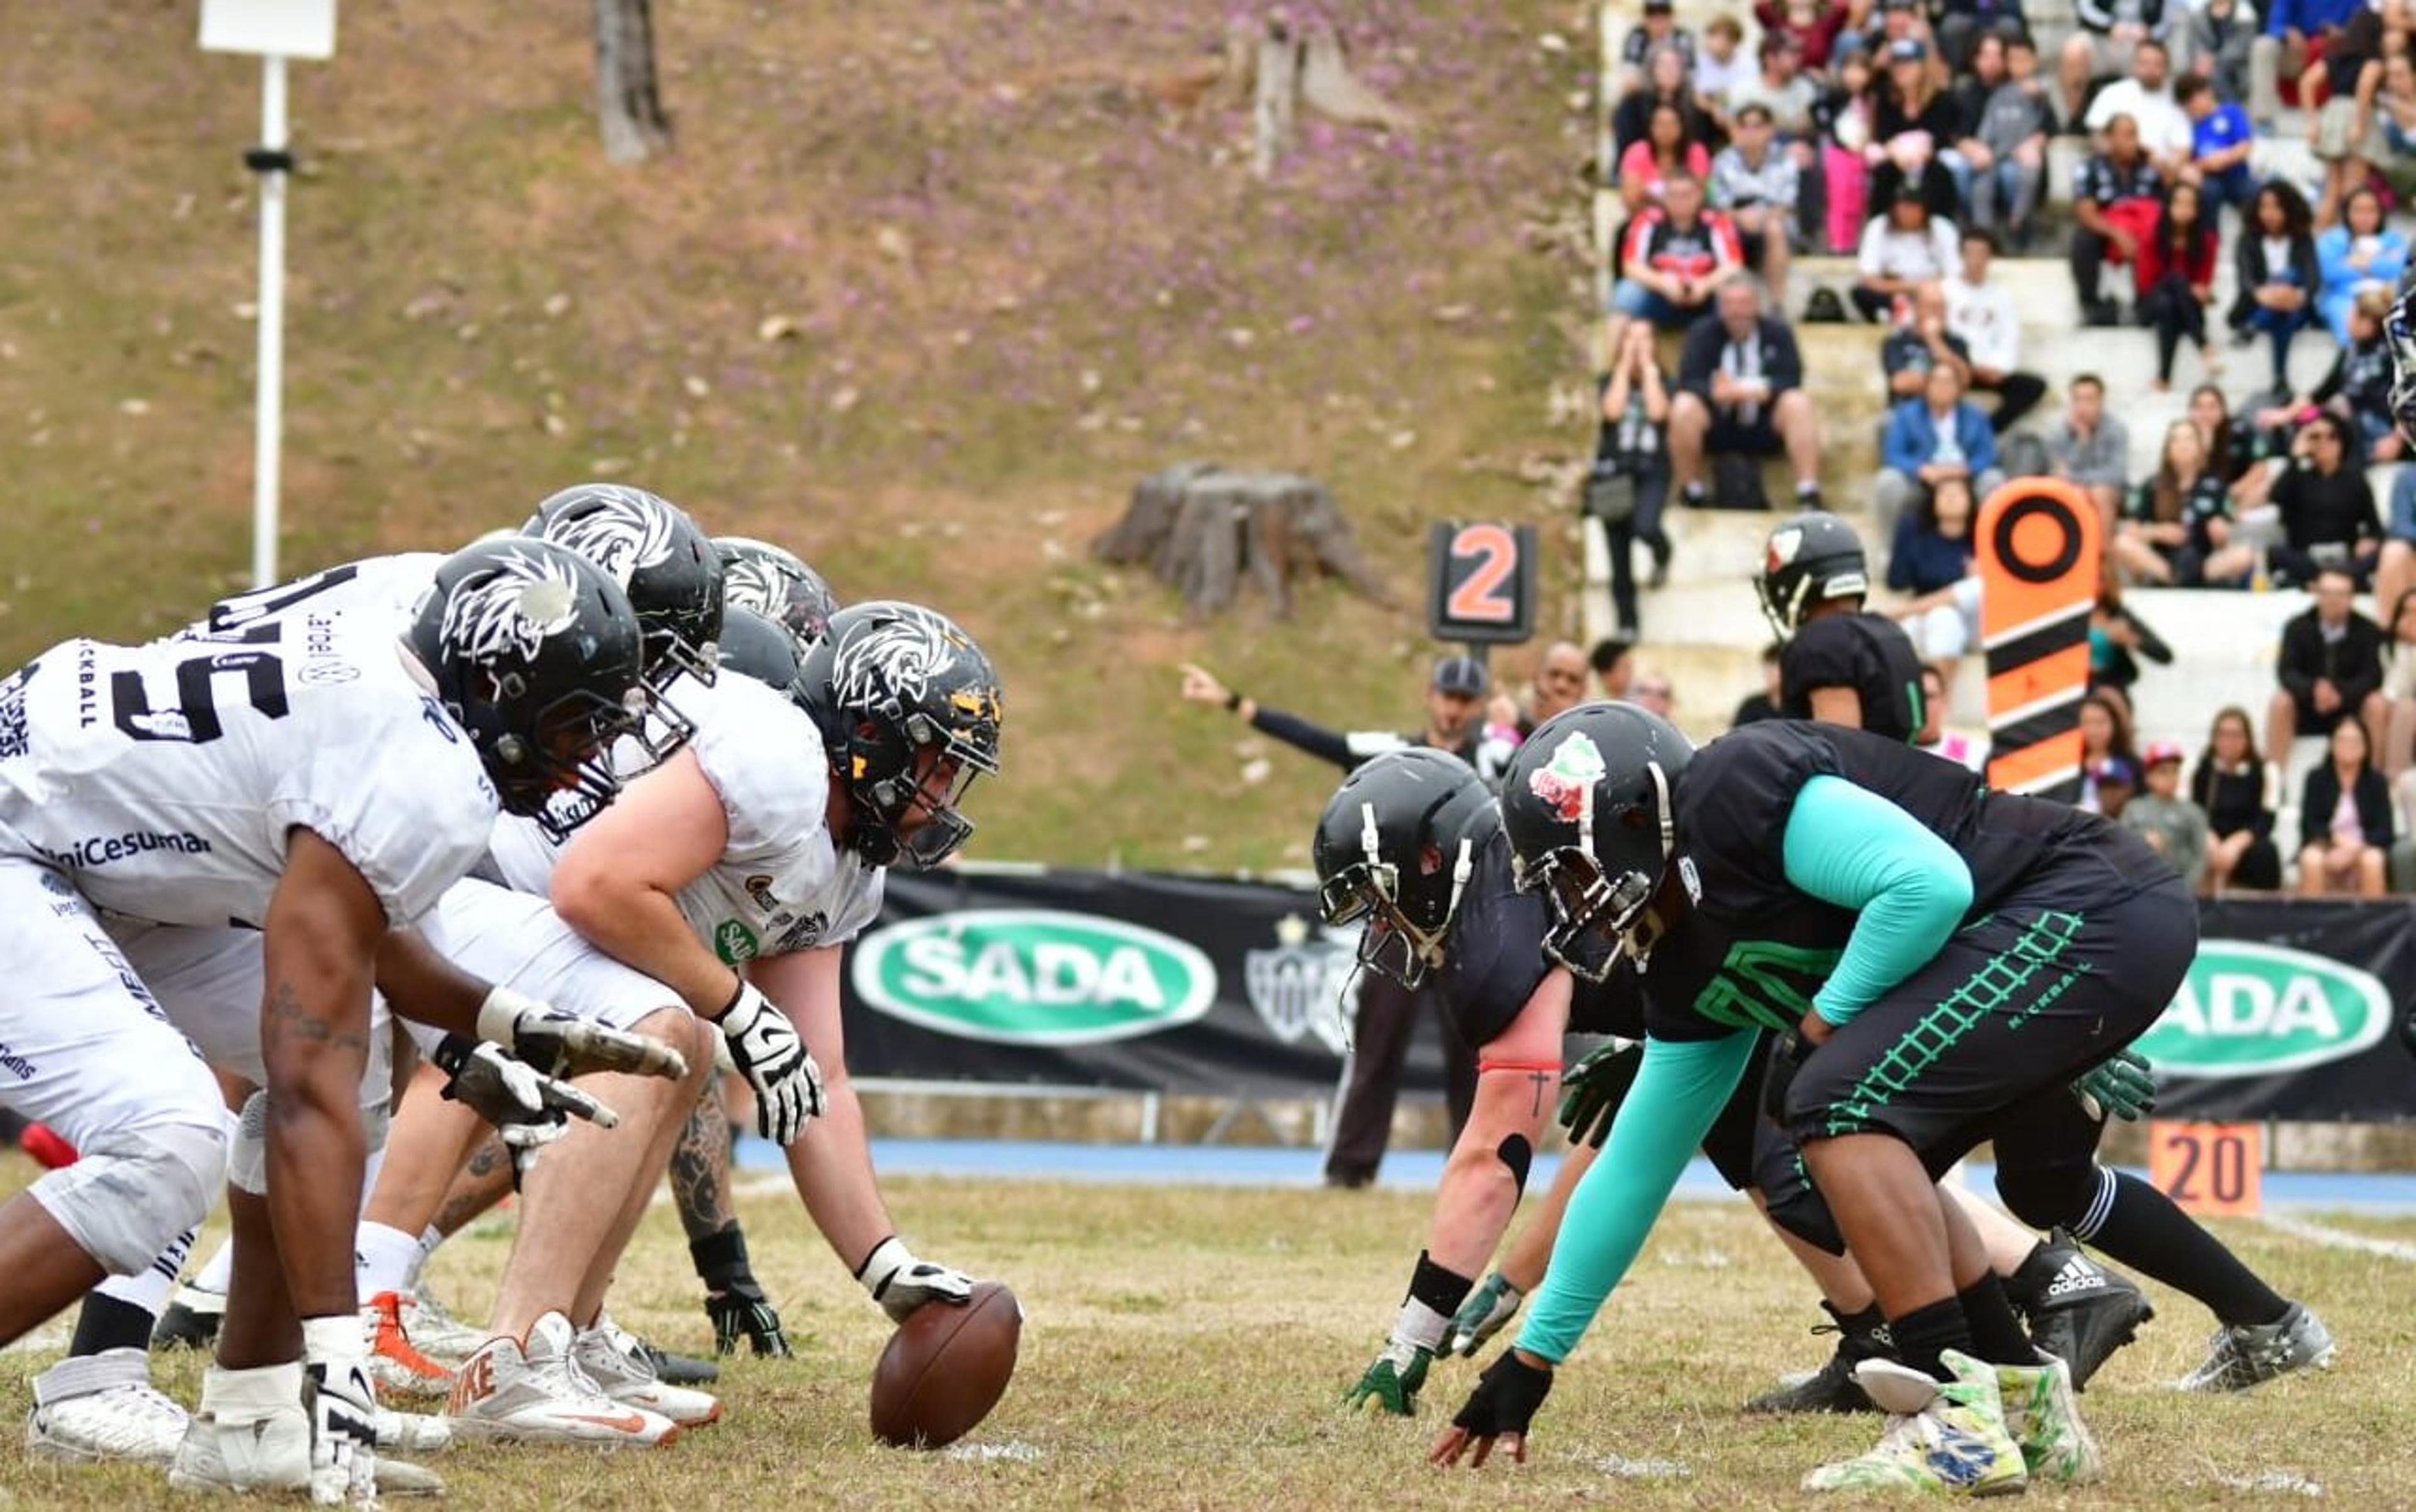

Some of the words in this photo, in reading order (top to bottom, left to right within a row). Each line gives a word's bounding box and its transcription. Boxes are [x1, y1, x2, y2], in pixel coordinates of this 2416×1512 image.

[1448, 523, 1518, 622] 2
[900, 934, 1166, 1011] SADA
[2167, 1136, 2245, 1203] 20
[2048, 1275, 2106, 1296] adidas
